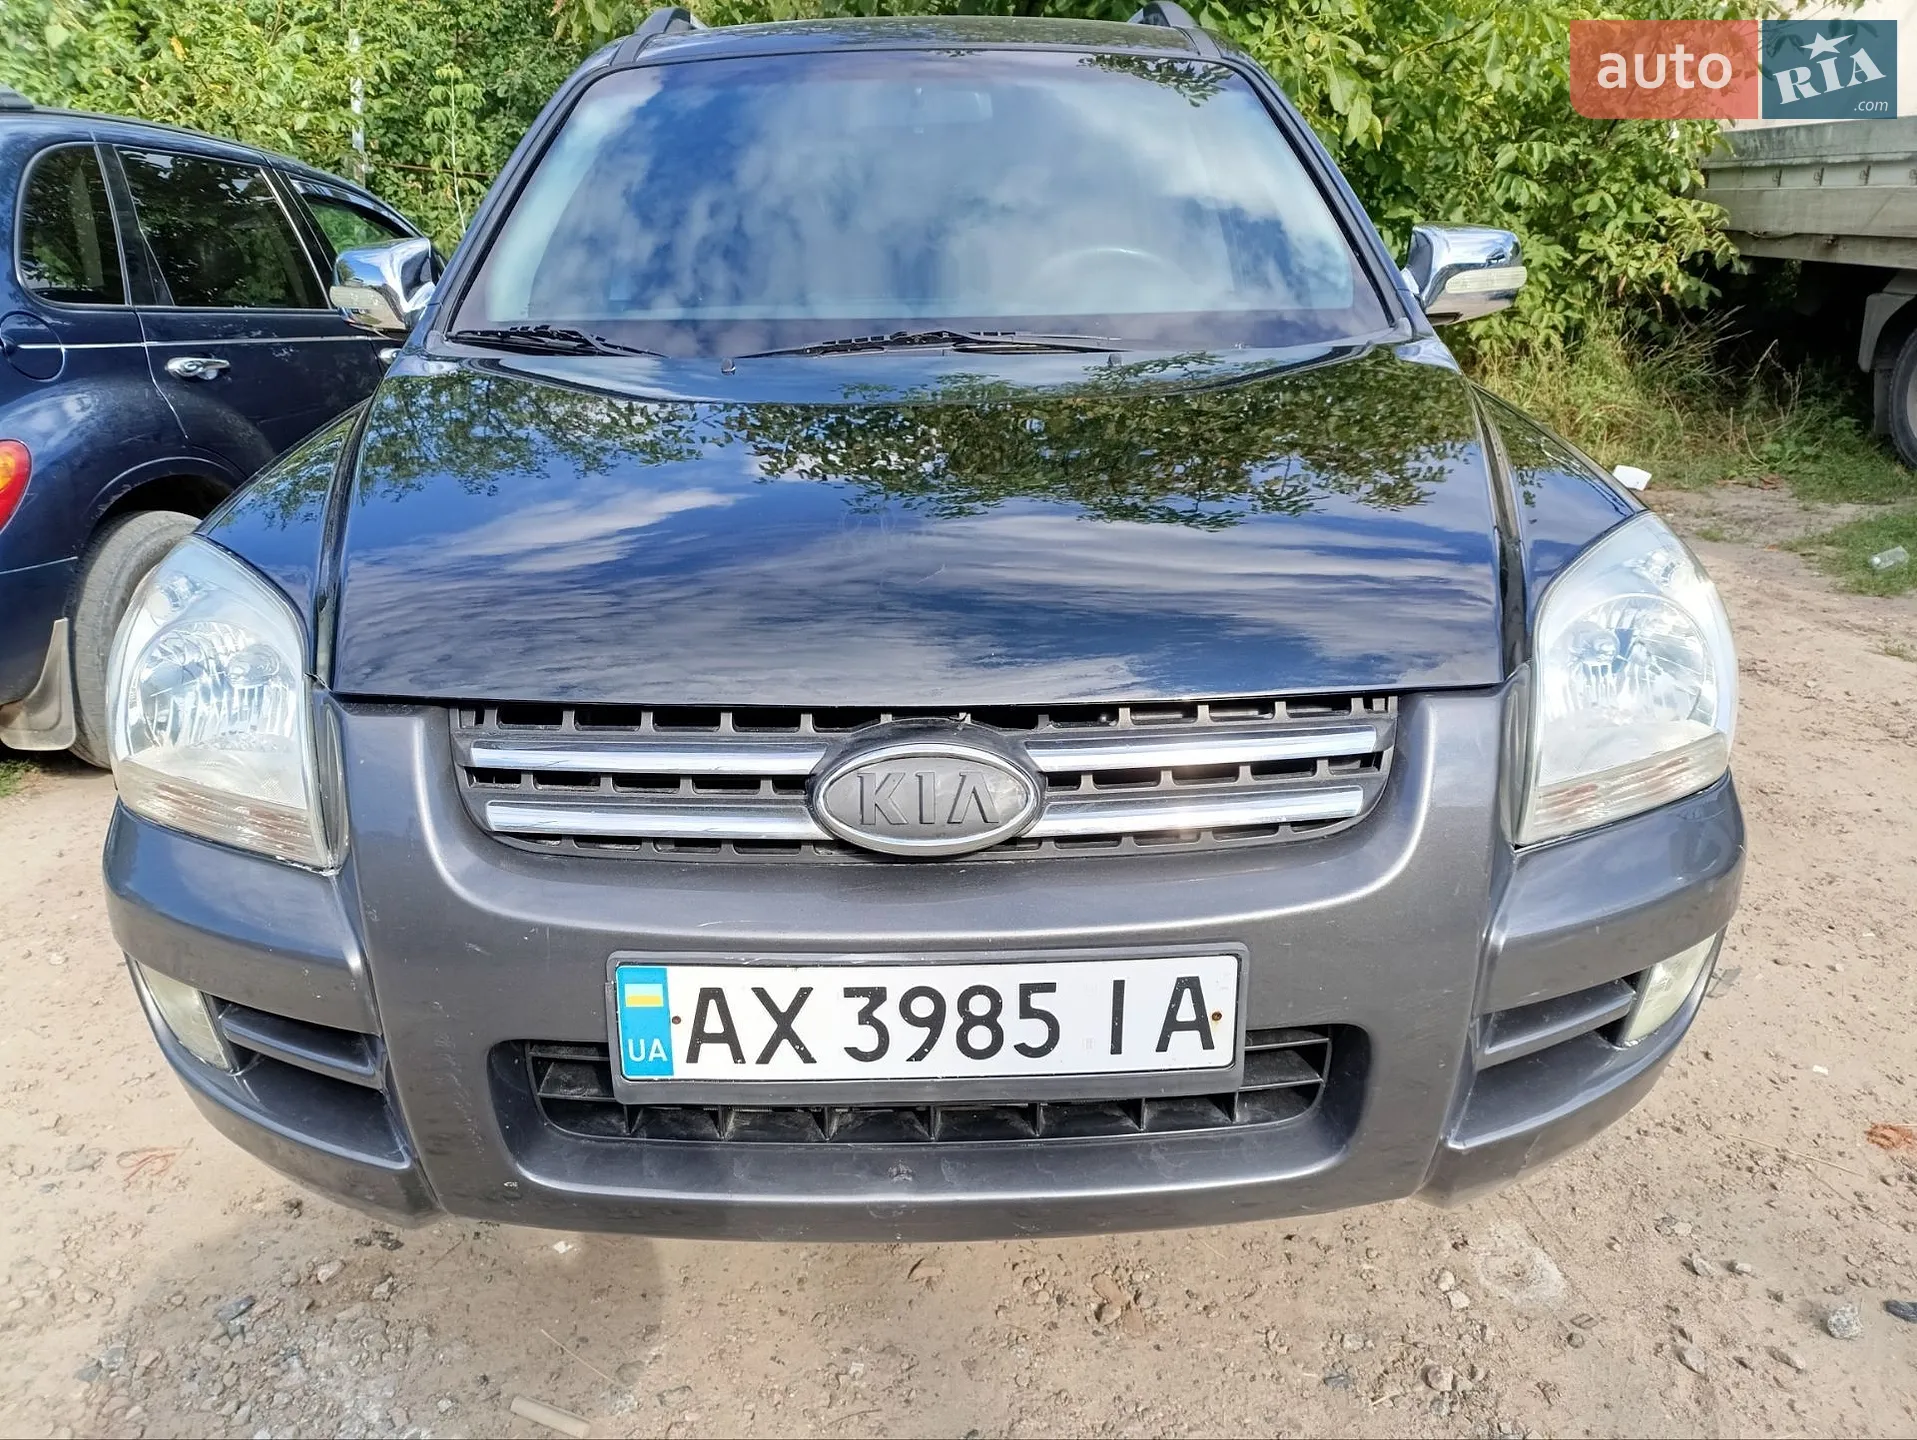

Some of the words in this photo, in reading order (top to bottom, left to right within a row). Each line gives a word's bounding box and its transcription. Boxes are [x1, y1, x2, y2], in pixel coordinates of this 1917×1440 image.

[857, 772, 999, 825] KIA
[686, 986, 818, 1065] AX
[843, 982, 1060, 1062] 3985
[1110, 976, 1215, 1055] IA
[630, 1037, 668, 1062] UA
